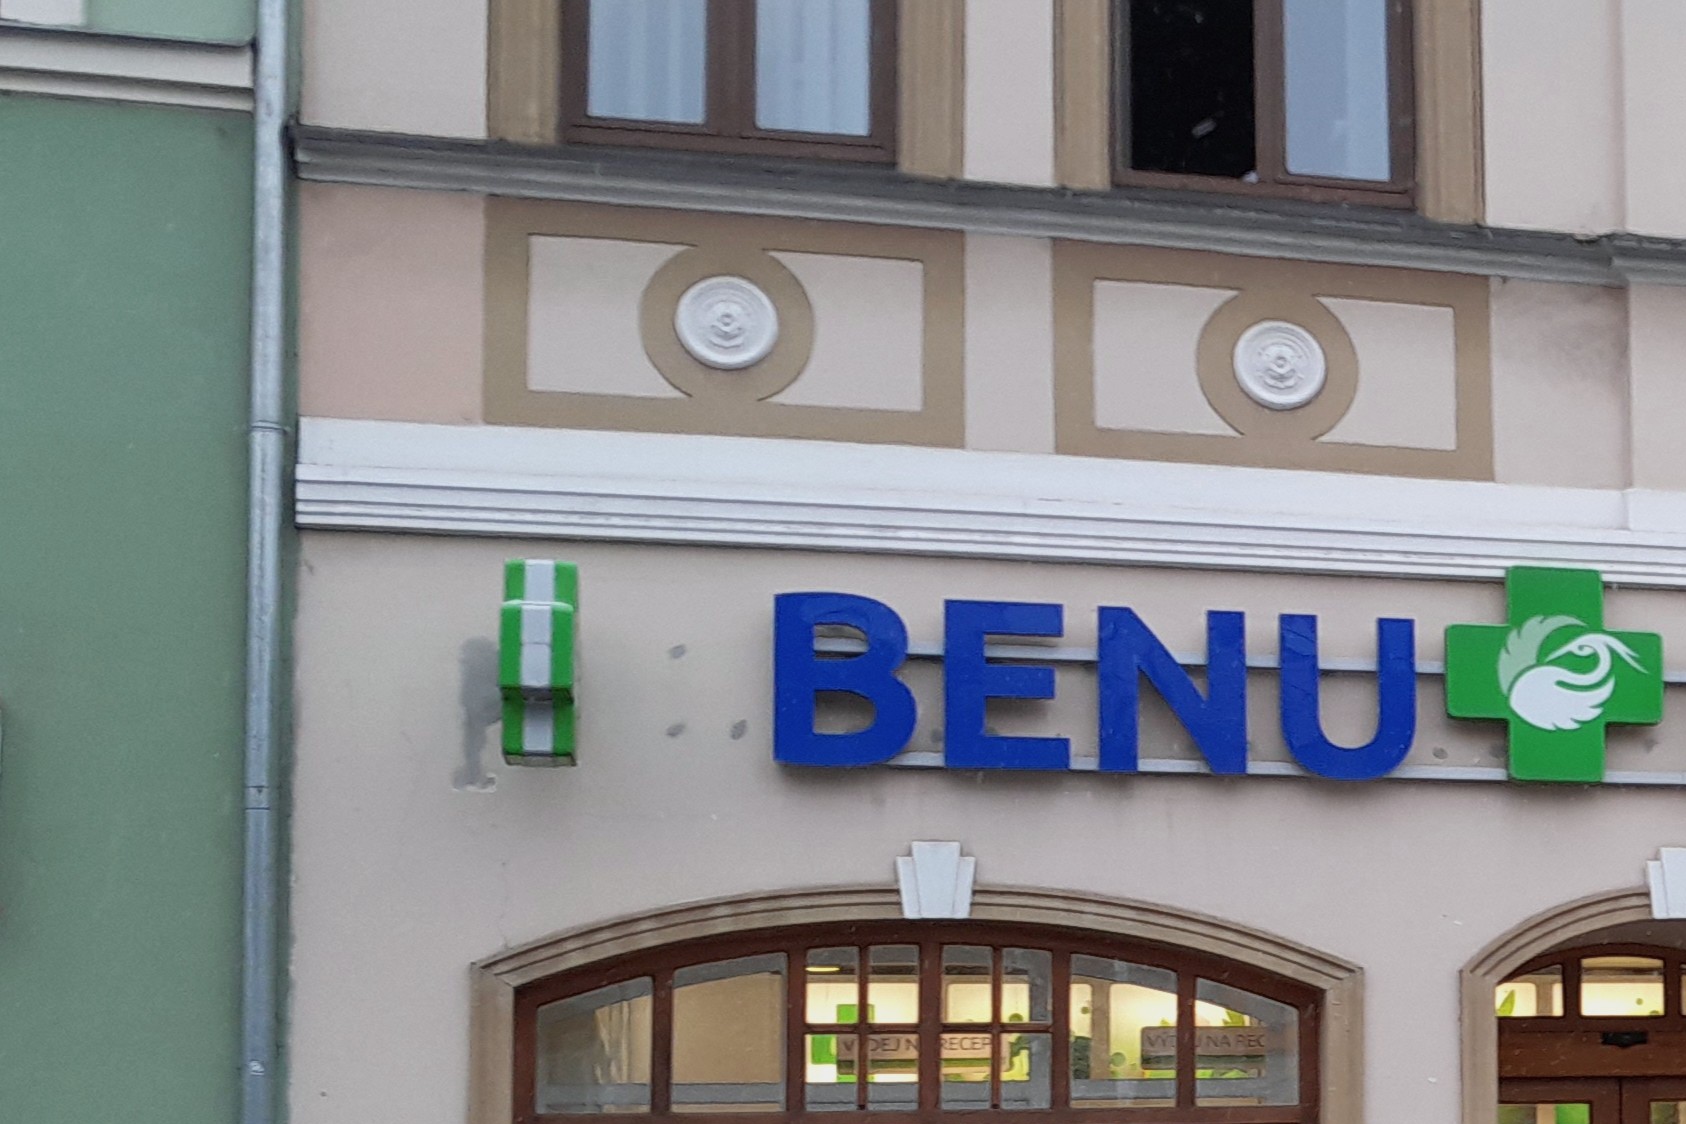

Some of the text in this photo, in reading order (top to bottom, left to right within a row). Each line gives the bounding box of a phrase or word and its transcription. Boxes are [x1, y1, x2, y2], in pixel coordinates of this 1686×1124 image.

[773, 591, 1416, 782] BENU
[841, 1036, 899, 1051] VDEJ
[940, 1036, 992, 1051] RECEP
